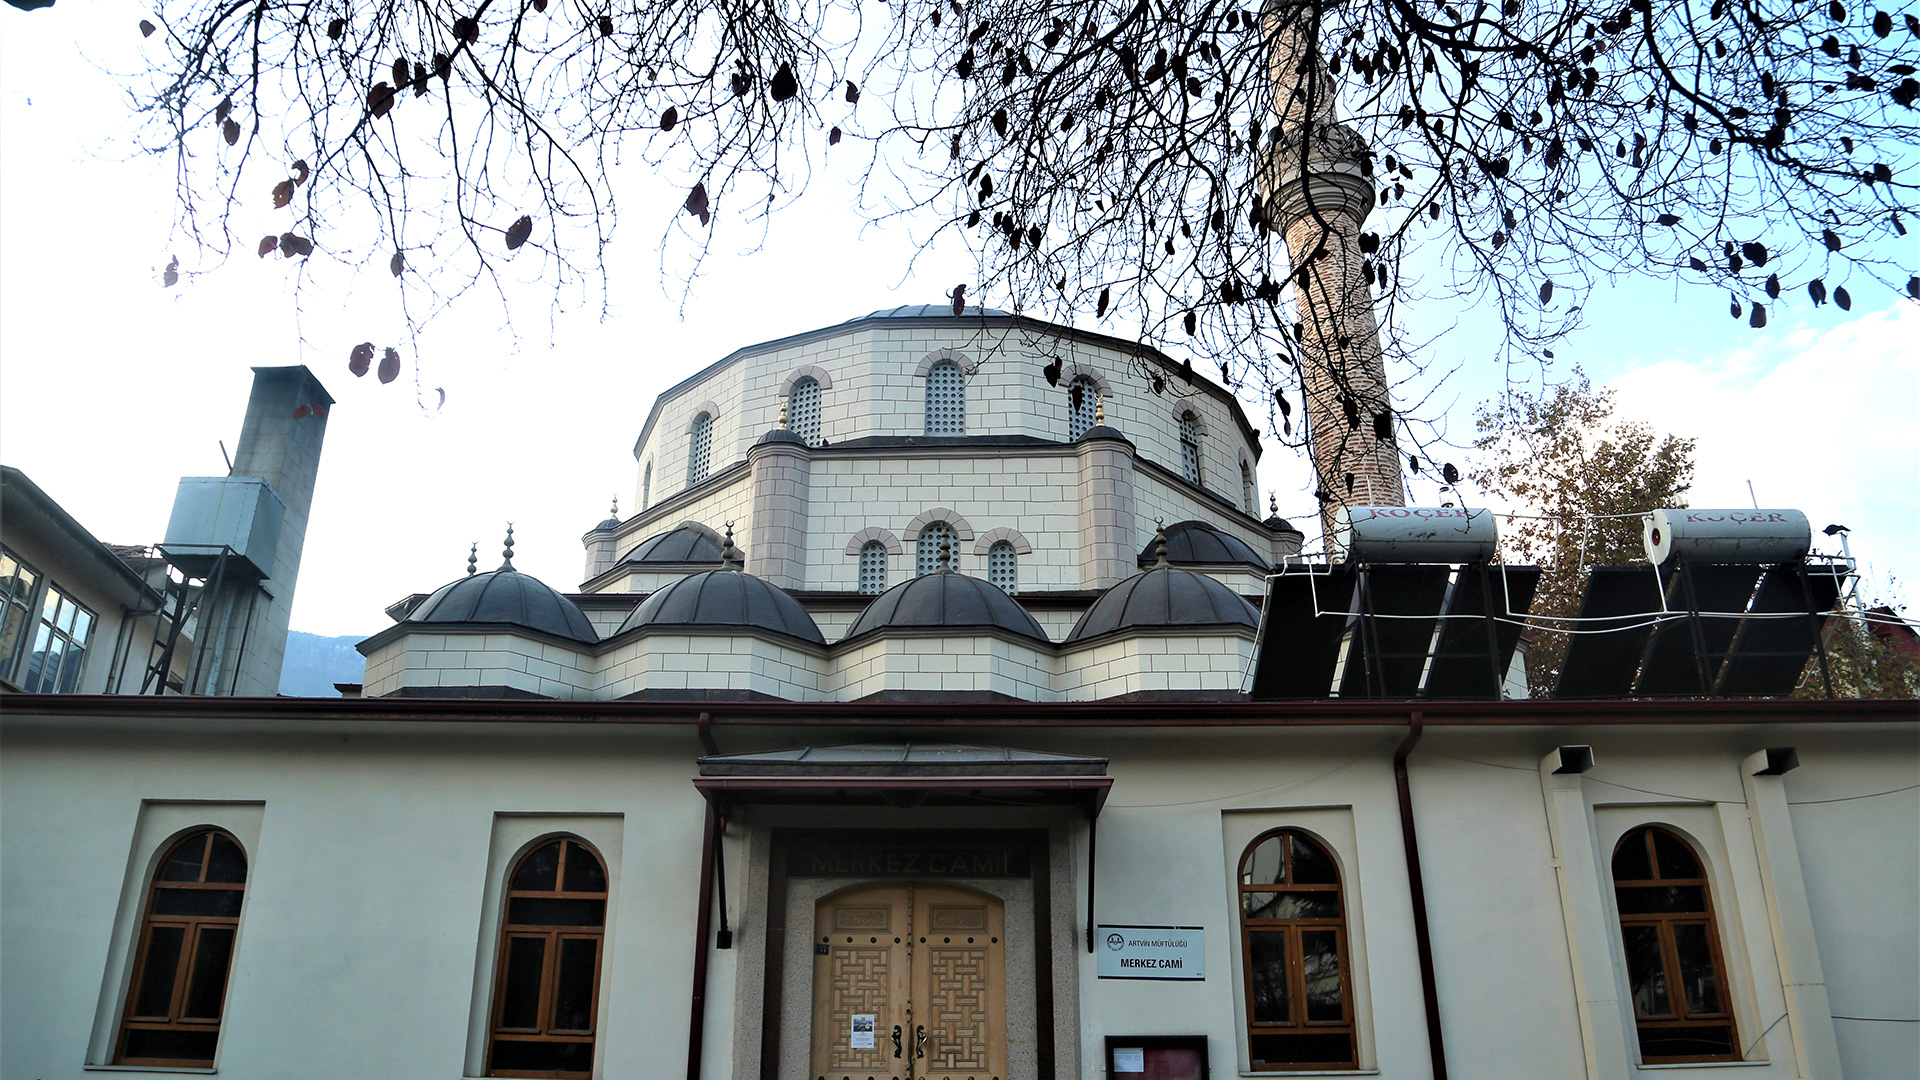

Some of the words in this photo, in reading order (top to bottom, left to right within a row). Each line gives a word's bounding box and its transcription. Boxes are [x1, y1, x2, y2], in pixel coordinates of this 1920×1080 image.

[811, 853, 921, 873] MERKEZ
[1128, 939, 1150, 947] ARTVİN
[1151, 939, 1188, 948] MÜFTÜLÜĞÜ
[1120, 958, 1157, 968] MERKEZ
[1158, 957, 1183, 969] CAMİ
